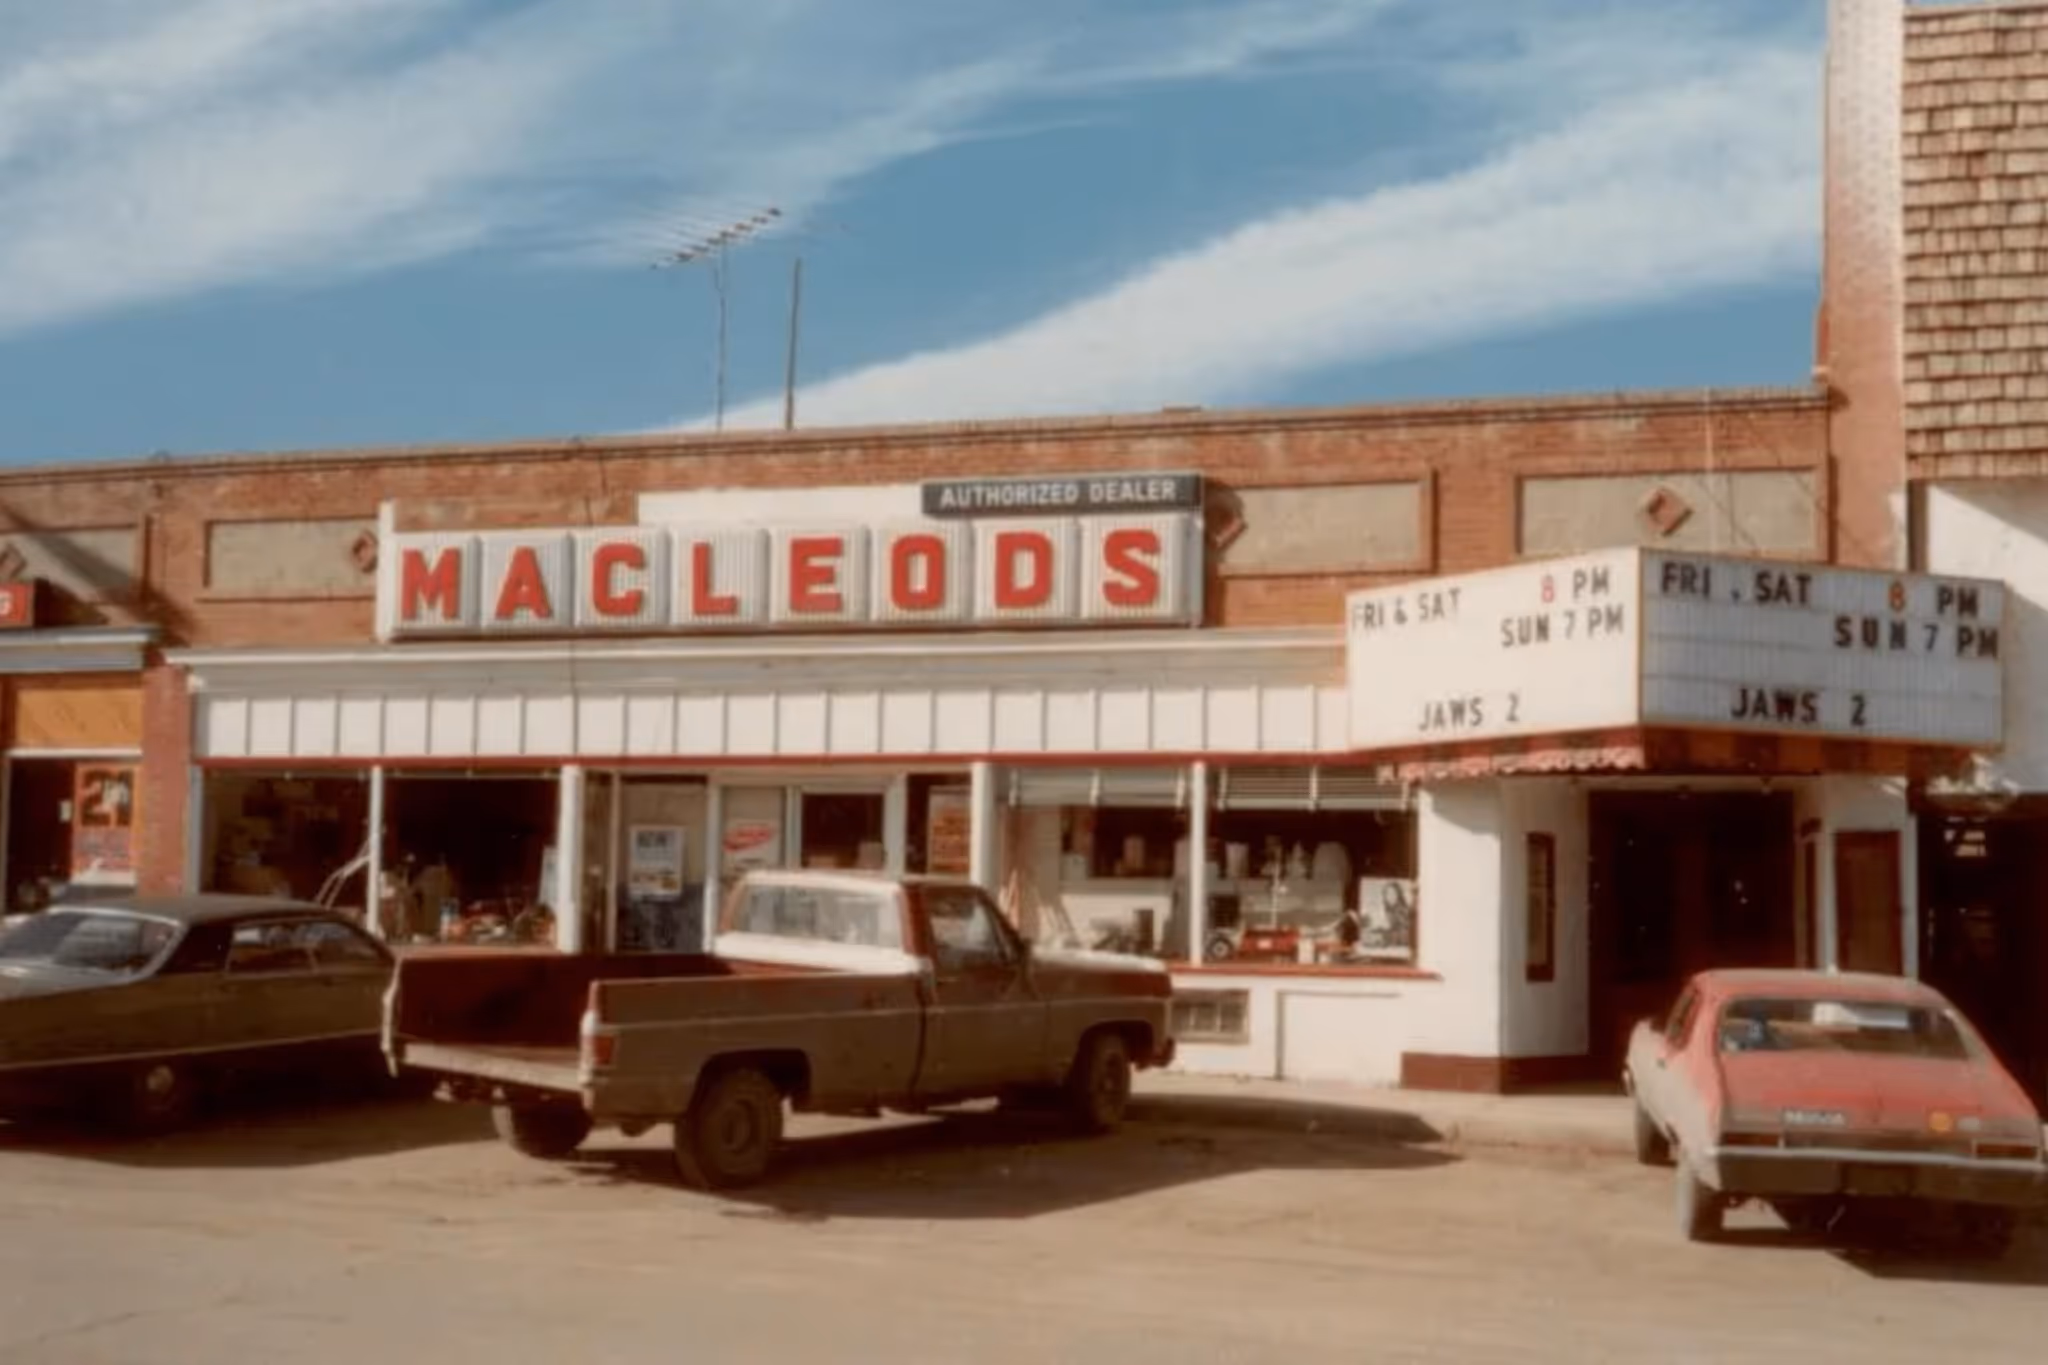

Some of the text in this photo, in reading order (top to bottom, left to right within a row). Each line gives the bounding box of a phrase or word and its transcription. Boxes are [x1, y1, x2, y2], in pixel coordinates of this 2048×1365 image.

[940, 479, 1177, 508] AUTHORIZED DEALER
[401, 528, 1161, 621] MACLEODS
[1352, 602, 1384, 630] FRI
[1417, 587, 1460, 622] SAT
[1540, 574, 1555, 603] 8
[1572, 565, 1610, 600] PM
[1661, 561, 1712, 598] FRI
[1754, 570, 1812, 604] SAT
[1937, 585, 1979, 618] PM
[1500, 602, 1625, 648] SUN 7 PM
[1834, 615, 1999, 662] SUN 7 PM
[1417, 694, 1520, 732] JAWS 2
[1731, 686, 1866, 725] JAWS 2
